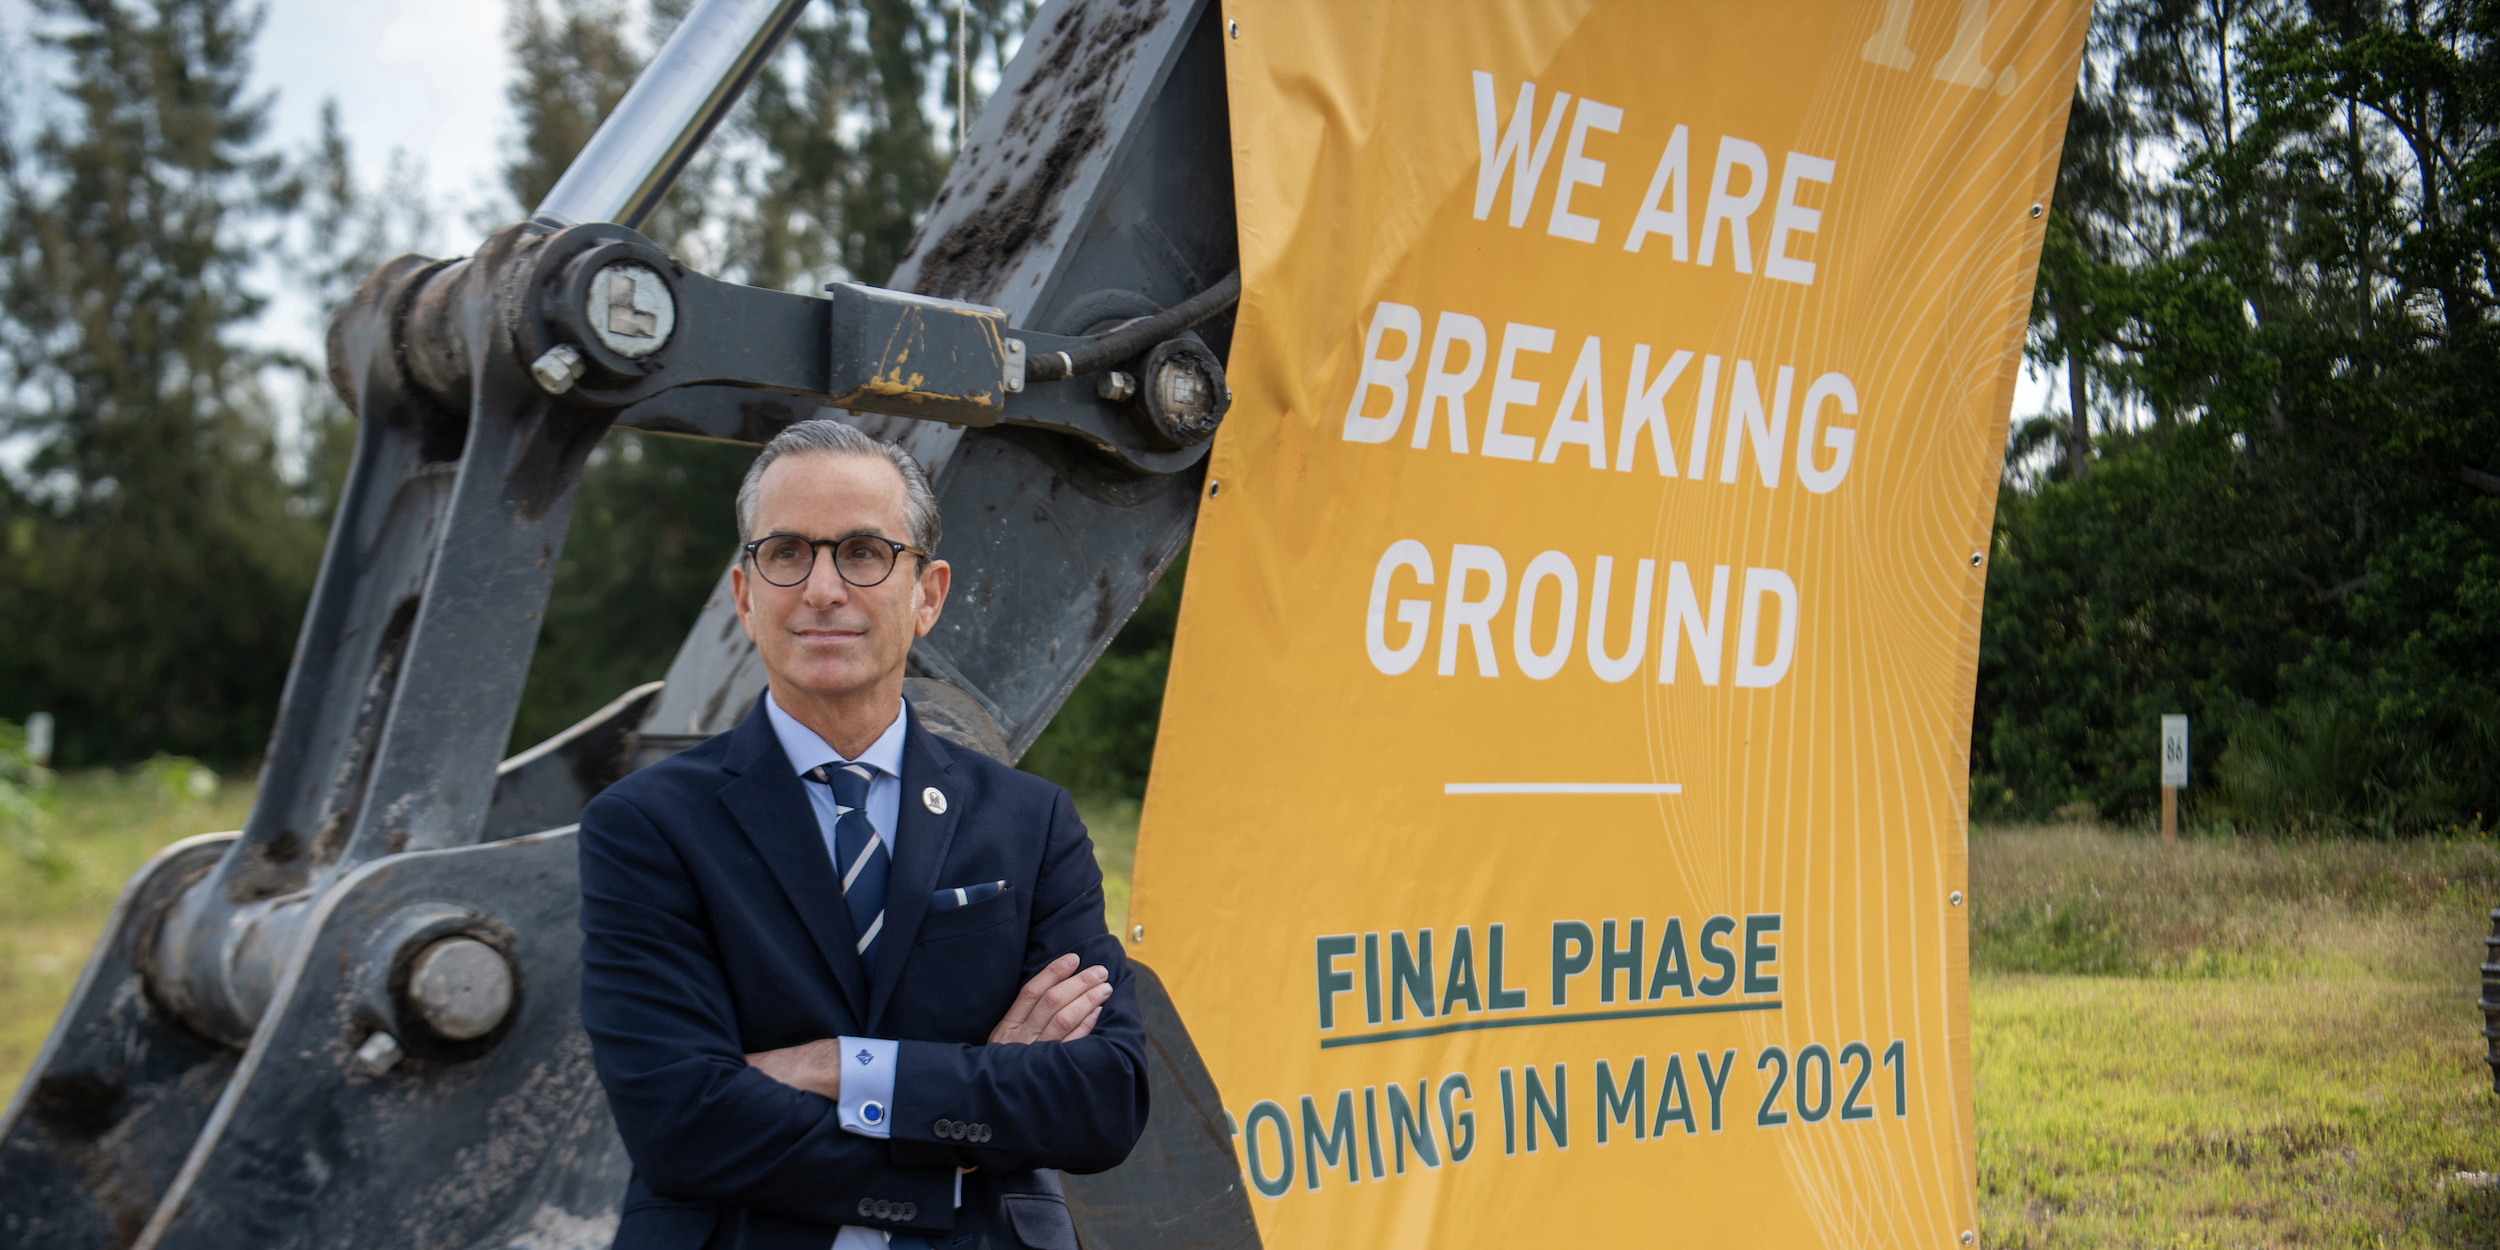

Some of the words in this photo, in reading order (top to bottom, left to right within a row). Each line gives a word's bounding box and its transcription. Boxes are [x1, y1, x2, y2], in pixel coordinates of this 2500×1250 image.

[1472, 69, 1625, 245] WE
[1623, 123, 1837, 286] ARE
[1342, 301, 1859, 495] BREAKING
[1365, 538, 1799, 689] GROUND
[2166, 735, 2184, 764] 86
[1315, 922, 1528, 1031] FINAL
[1551, 914, 1783, 1007] PHASE
[1224, 1071, 1477, 1200] OMING
[1499, 1062, 1569, 1155] IN
[1595, 1048, 1736, 1145] MAY
[1756, 1039, 1908, 1128] 2021
